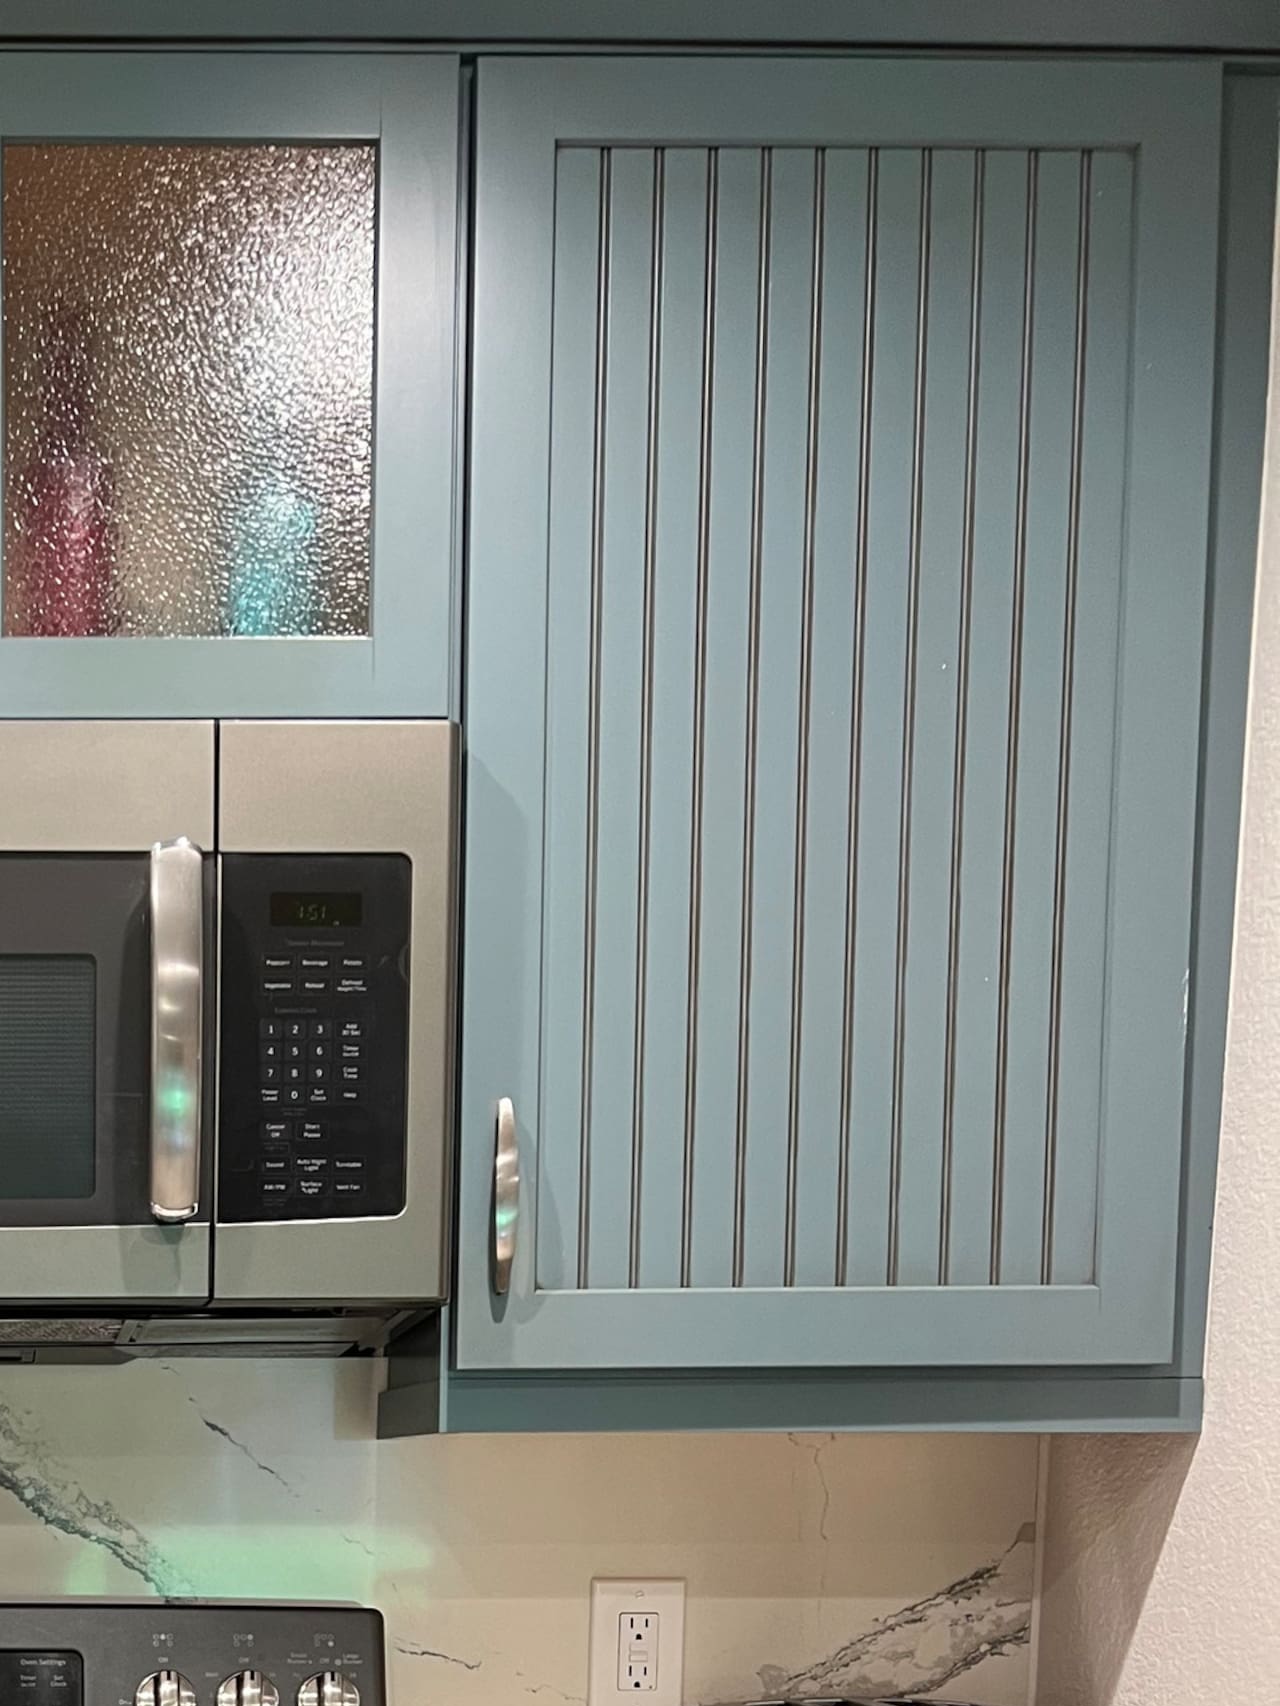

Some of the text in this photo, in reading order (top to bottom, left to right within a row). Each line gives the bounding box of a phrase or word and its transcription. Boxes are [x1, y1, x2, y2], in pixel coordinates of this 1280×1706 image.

[268, 1024, 274, 1035] 1
[292, 1024, 299, 1035] 2
[317, 1024, 323, 1035] 3
[267, 1046, 274, 1055] 4
[291, 1046, 299, 1056] 5
[316, 1046, 323, 1055] 6
[267, 1068, 274, 1078] 7
[291, 1068, 298, 1078] 8
[315, 1068, 323, 1078] 9
[291, 1090, 298, 1100] 0
